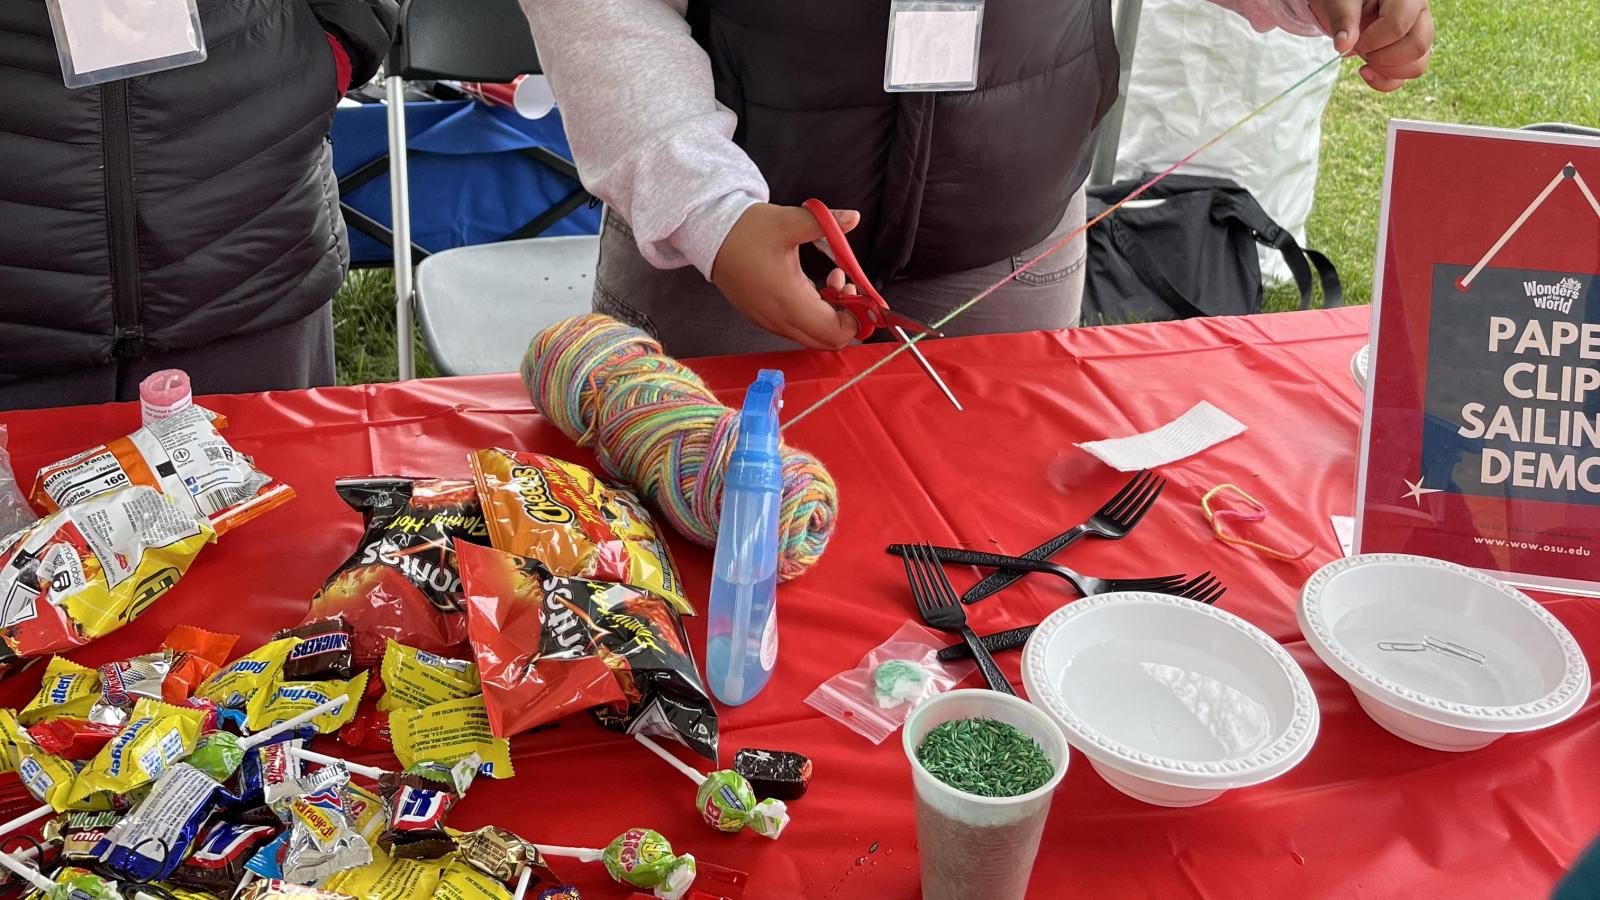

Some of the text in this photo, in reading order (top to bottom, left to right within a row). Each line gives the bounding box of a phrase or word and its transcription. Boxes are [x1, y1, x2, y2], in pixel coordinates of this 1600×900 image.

[1523, 280, 1579, 300] Wonders
[1533, 297, 1573, 314] World
[1489, 316, 1600, 360] PAPE
[1503, 362, 1600, 403] CLIP
[43, 462, 84, 490] Nutrition
[83, 453, 112, 466] Facts
[104, 473, 126, 487] 160
[384, 515, 426, 533] Hot
[1473, 536, 1591, 556] www.wow.osu.edu
[292, 633, 348, 658] SNICKERS
[303, 805, 334, 838] Played!
